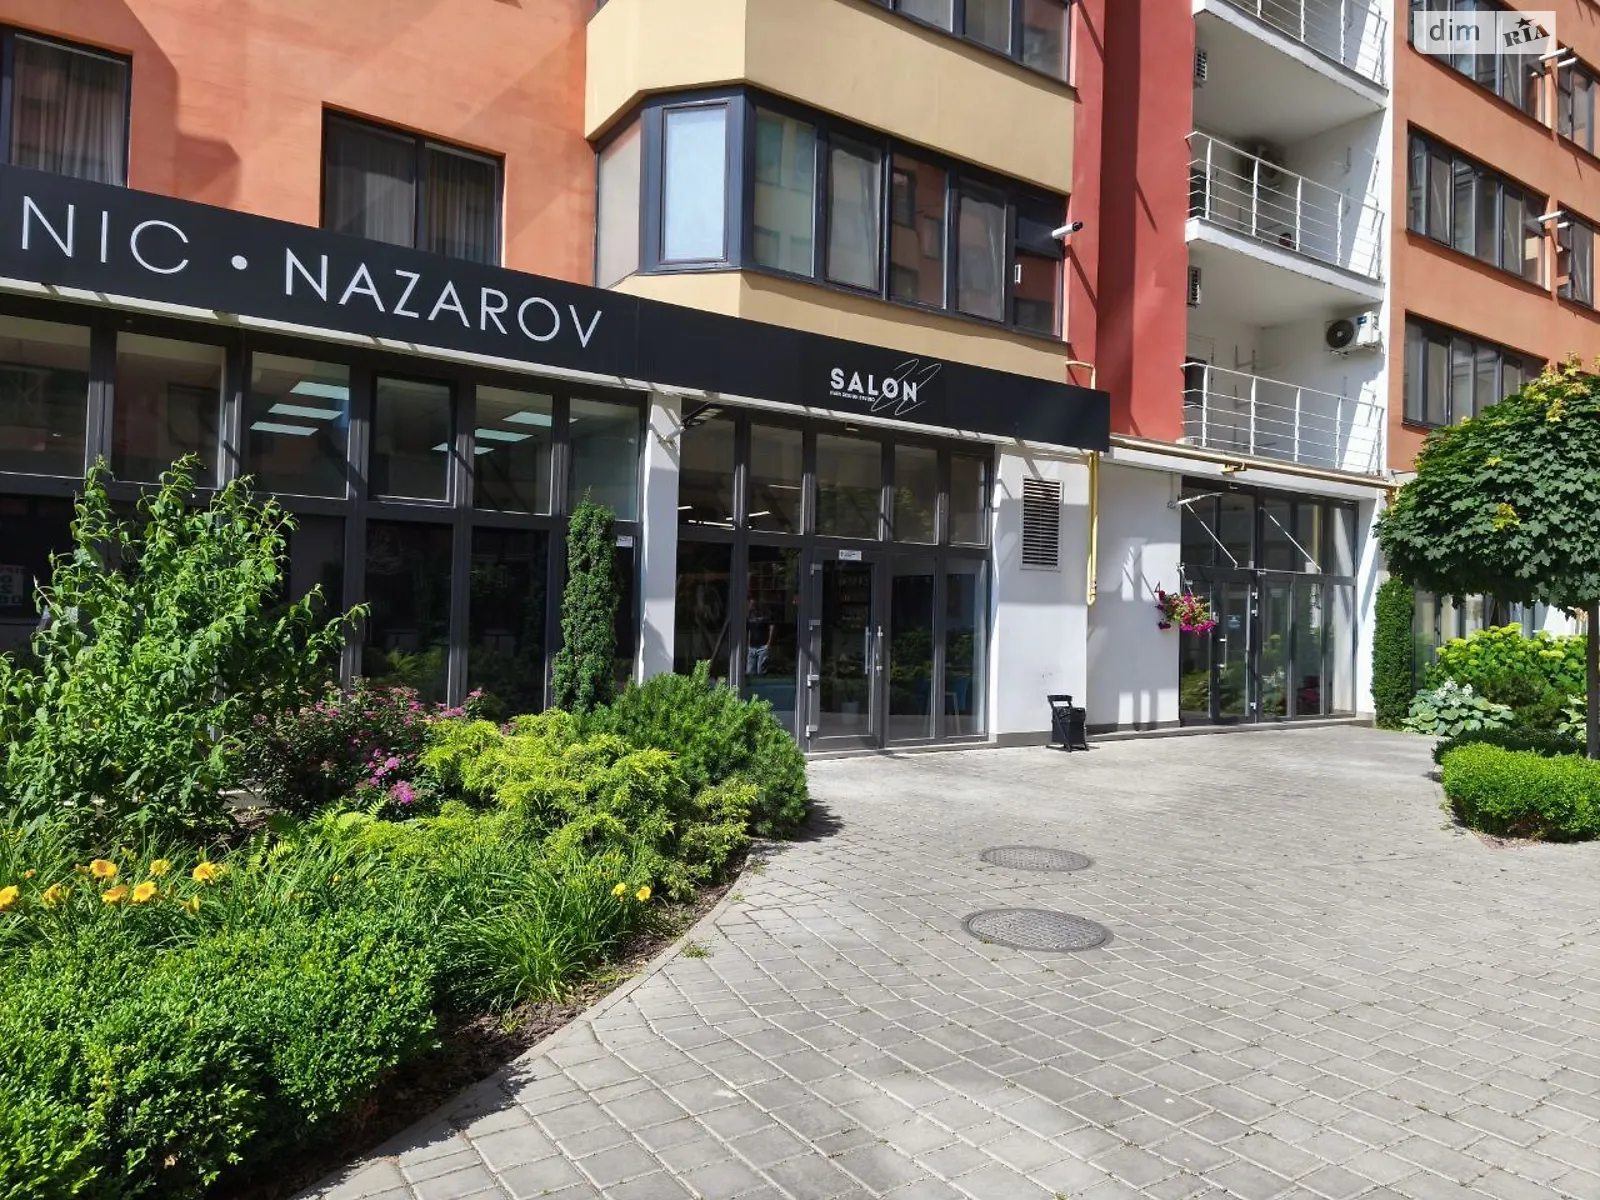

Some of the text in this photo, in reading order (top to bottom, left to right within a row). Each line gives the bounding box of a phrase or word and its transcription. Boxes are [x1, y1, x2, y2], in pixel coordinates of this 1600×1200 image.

[21, 195, 602, 349] NIC NAZAROV
[829, 367, 918, 403] SALON
